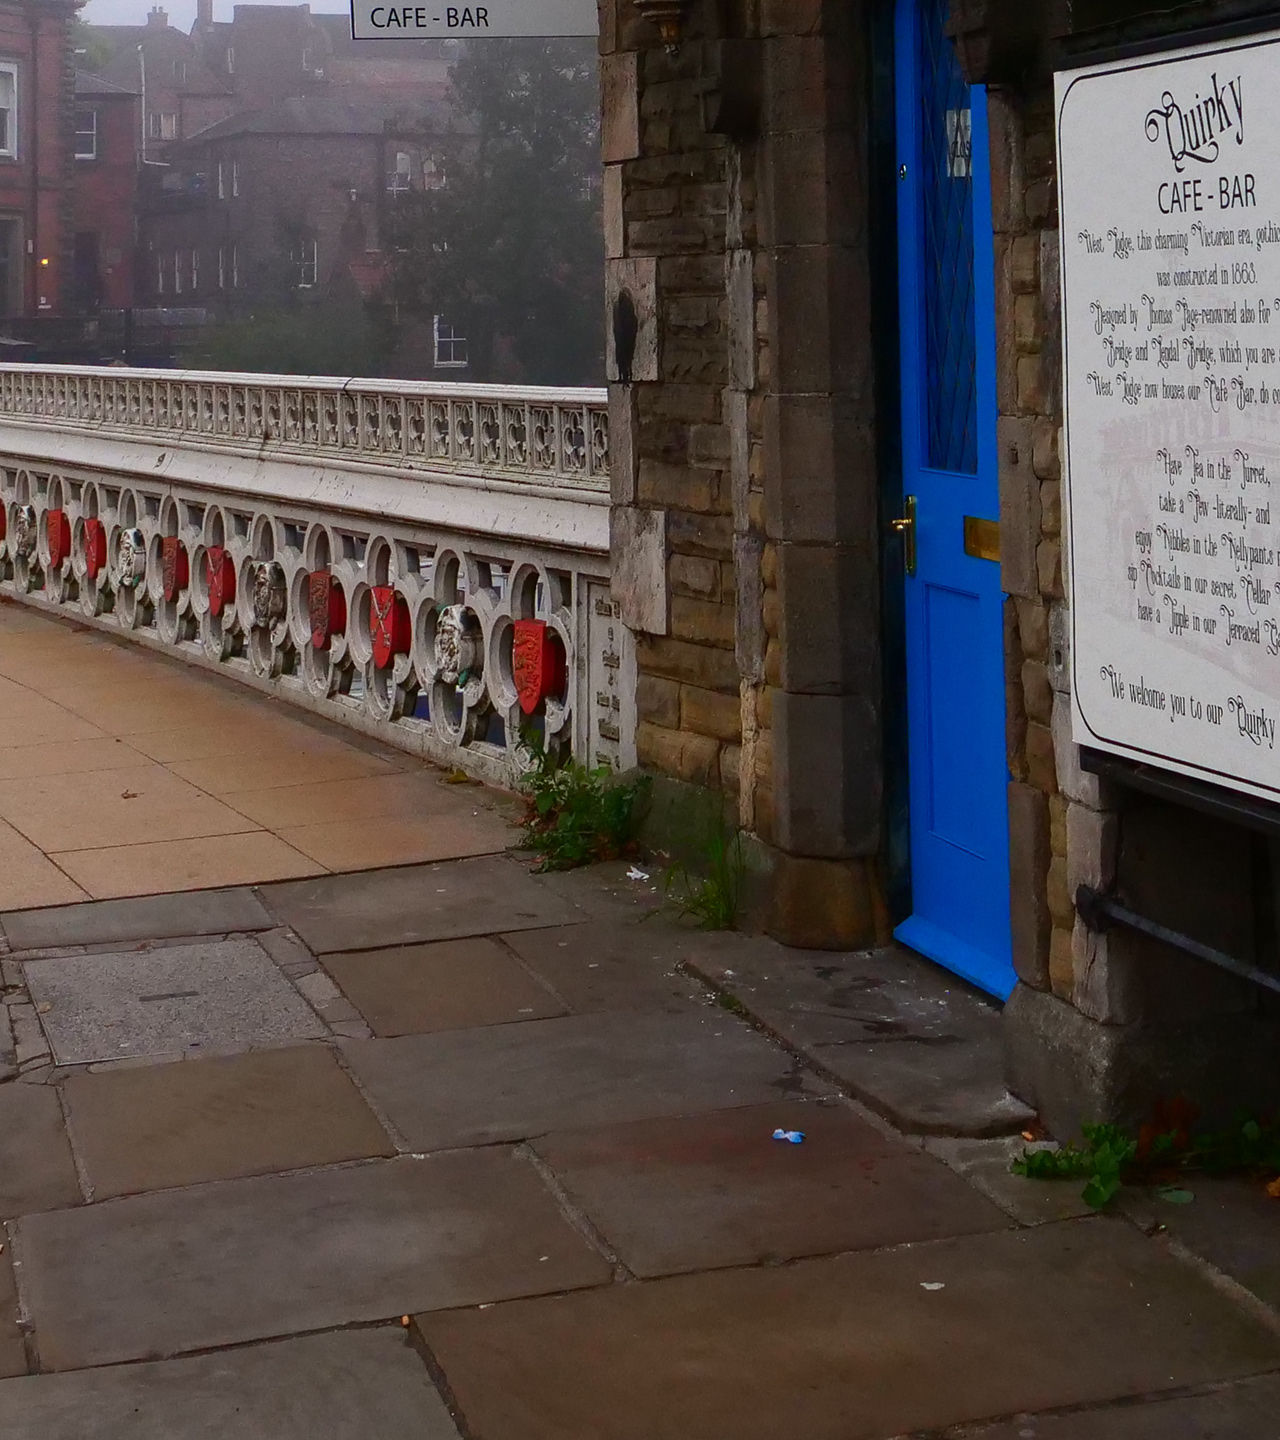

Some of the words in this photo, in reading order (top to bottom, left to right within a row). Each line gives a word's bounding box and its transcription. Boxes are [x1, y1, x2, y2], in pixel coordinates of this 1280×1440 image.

[371, 7, 427, 28] CAFE
[447, 7, 489, 27] BAR
[1144, 72, 1244, 173] Quirky
[1157, 179, 1203, 214] CAFE
[1219, 173, 1257, 208] BAR
[1078, 229, 1105, 254] West
[1107, 227, 1135, 260] Lodge,
[1137, 229, 1153, 251] this
[1154, 228, 1189, 256] charming
[1191, 220, 1234, 247] Victorian
[1238, 229, 1253, 246] era,
[1256, 220, 1280, 252] gothic
[1156, 271, 1171, 287] was
[1173, 263, 1218, 286] constructed
[1220, 265, 1229, 285] in
[1089, 299, 1127, 335] Designed
[1129, 303, 1138, 332] by
[1141, 293, 1173, 332] Thomas
[1240, 299, 1255, 324] also
[1258, 298, 1271, 324] for
[1102, 335, 1132, 368] Bridge
[1135, 340, 1148, 361] and
[1151, 335, 1180, 369] Lendal
[1182, 335, 1217, 370] Bridge,
[1219, 341, 1242, 363] which
[1245, 347, 1258, 371] you
[1262, 347, 1275, 364] are
[1086, 371, 1114, 397] West
[1144, 383, 1159, 398] now
[1162, 378, 1185, 400] houses
[1188, 384, 1201, 401] our
[1203, 374, 1228, 413] Cafe
[1260, 381, 1270, 404] do
[1156, 447, 1183, 486] Have
[1185, 444, 1204, 485] Tea
[1207, 459, 1215, 479] in
[1217, 458, 1232, 480] the
[1233, 448, 1271, 490] Turret,
[1159, 491, 1177, 513] take
[1179, 502, 1184, 514] a
[1255, 502, 1271, 525] and
[1135, 528, 1153, 555] enjoy
[1156, 522, 1190, 562] Nibbles
[1193, 534, 1201, 554] in
[1204, 533, 1218, 556] the
[1127, 563, 1138, 590] sip
[1140, 558, 1181, 597] Cocktails
[1183, 572, 1192, 591] in
[1195, 578, 1208, 594] our
[1211, 580, 1237, 600] secret
[1240, 574, 1271, 615] Cellar
[1137, 598, 1154, 623] have
[1155, 608, 1161, 624] a
[1163, 593, 1189, 636] Tipple
[1192, 612, 1201, 632] in
[1203, 618, 1217, 635] our
[1219, 604, 1260, 646] Terraced
[1100, 664, 1125, 700] We
[1129, 676, 1166, 711] welcome
[1170, 693, 1186, 723] you
[1190, 695, 1202, 720] to
[1206, 702, 1224, 725] our
[1227, 694, 1276, 749] Quirky
